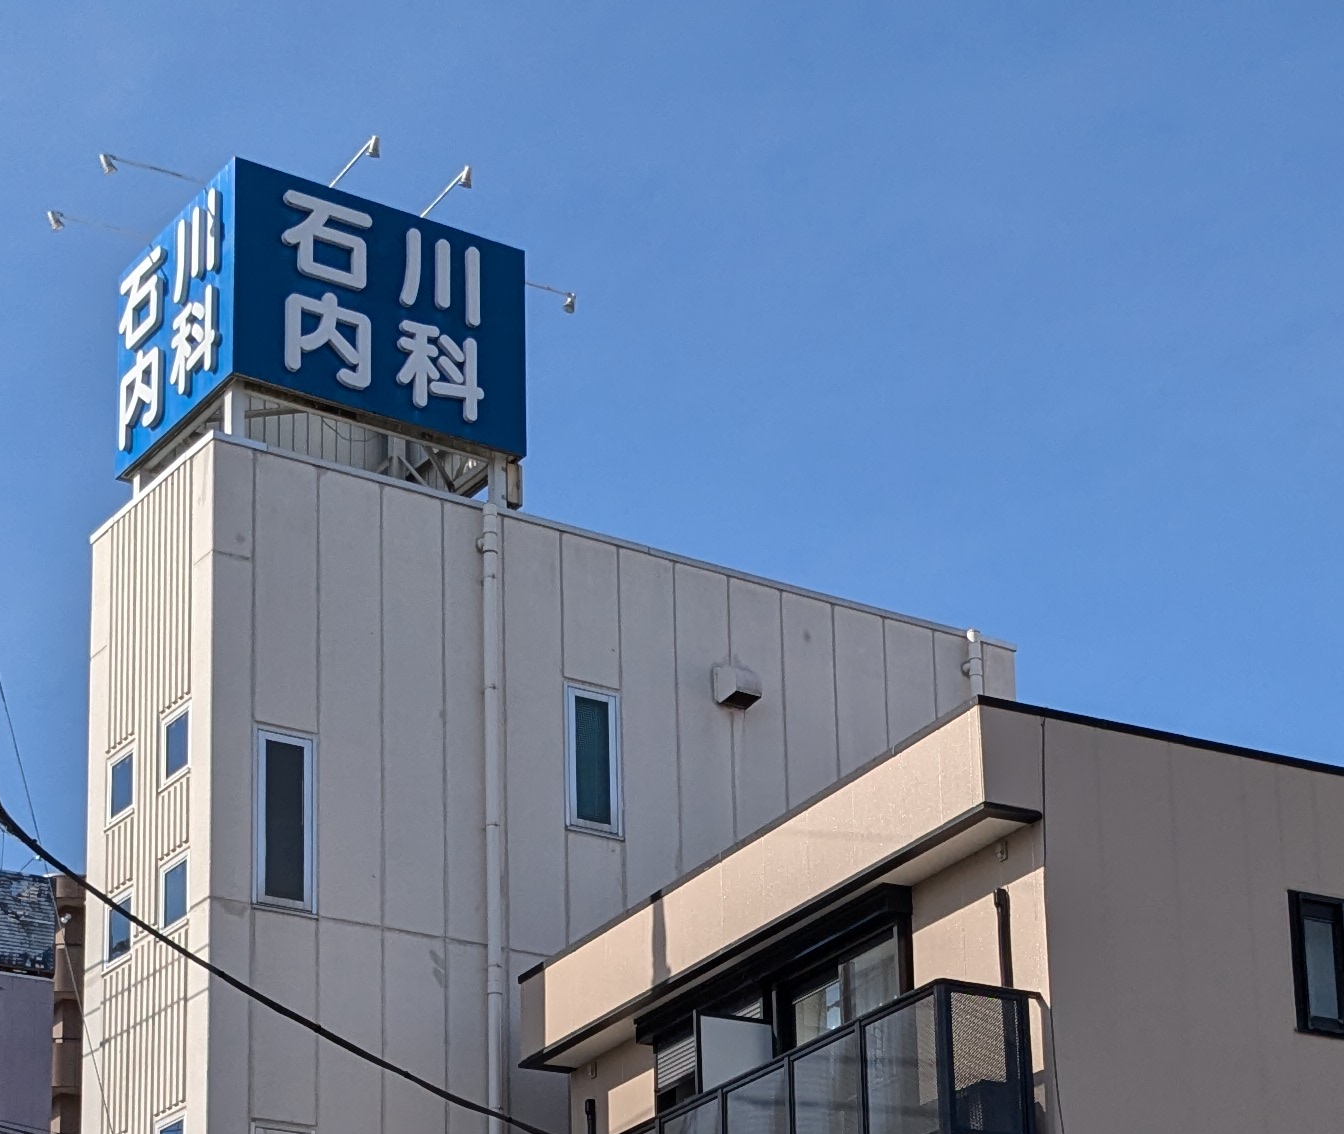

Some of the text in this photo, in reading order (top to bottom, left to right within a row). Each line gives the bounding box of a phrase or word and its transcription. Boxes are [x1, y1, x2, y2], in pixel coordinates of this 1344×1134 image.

[119, 188, 222, 350] 石川
[282, 189, 481, 328] 石川
[118, 284, 220, 452] 内科
[283, 292, 485, 424] 内科
